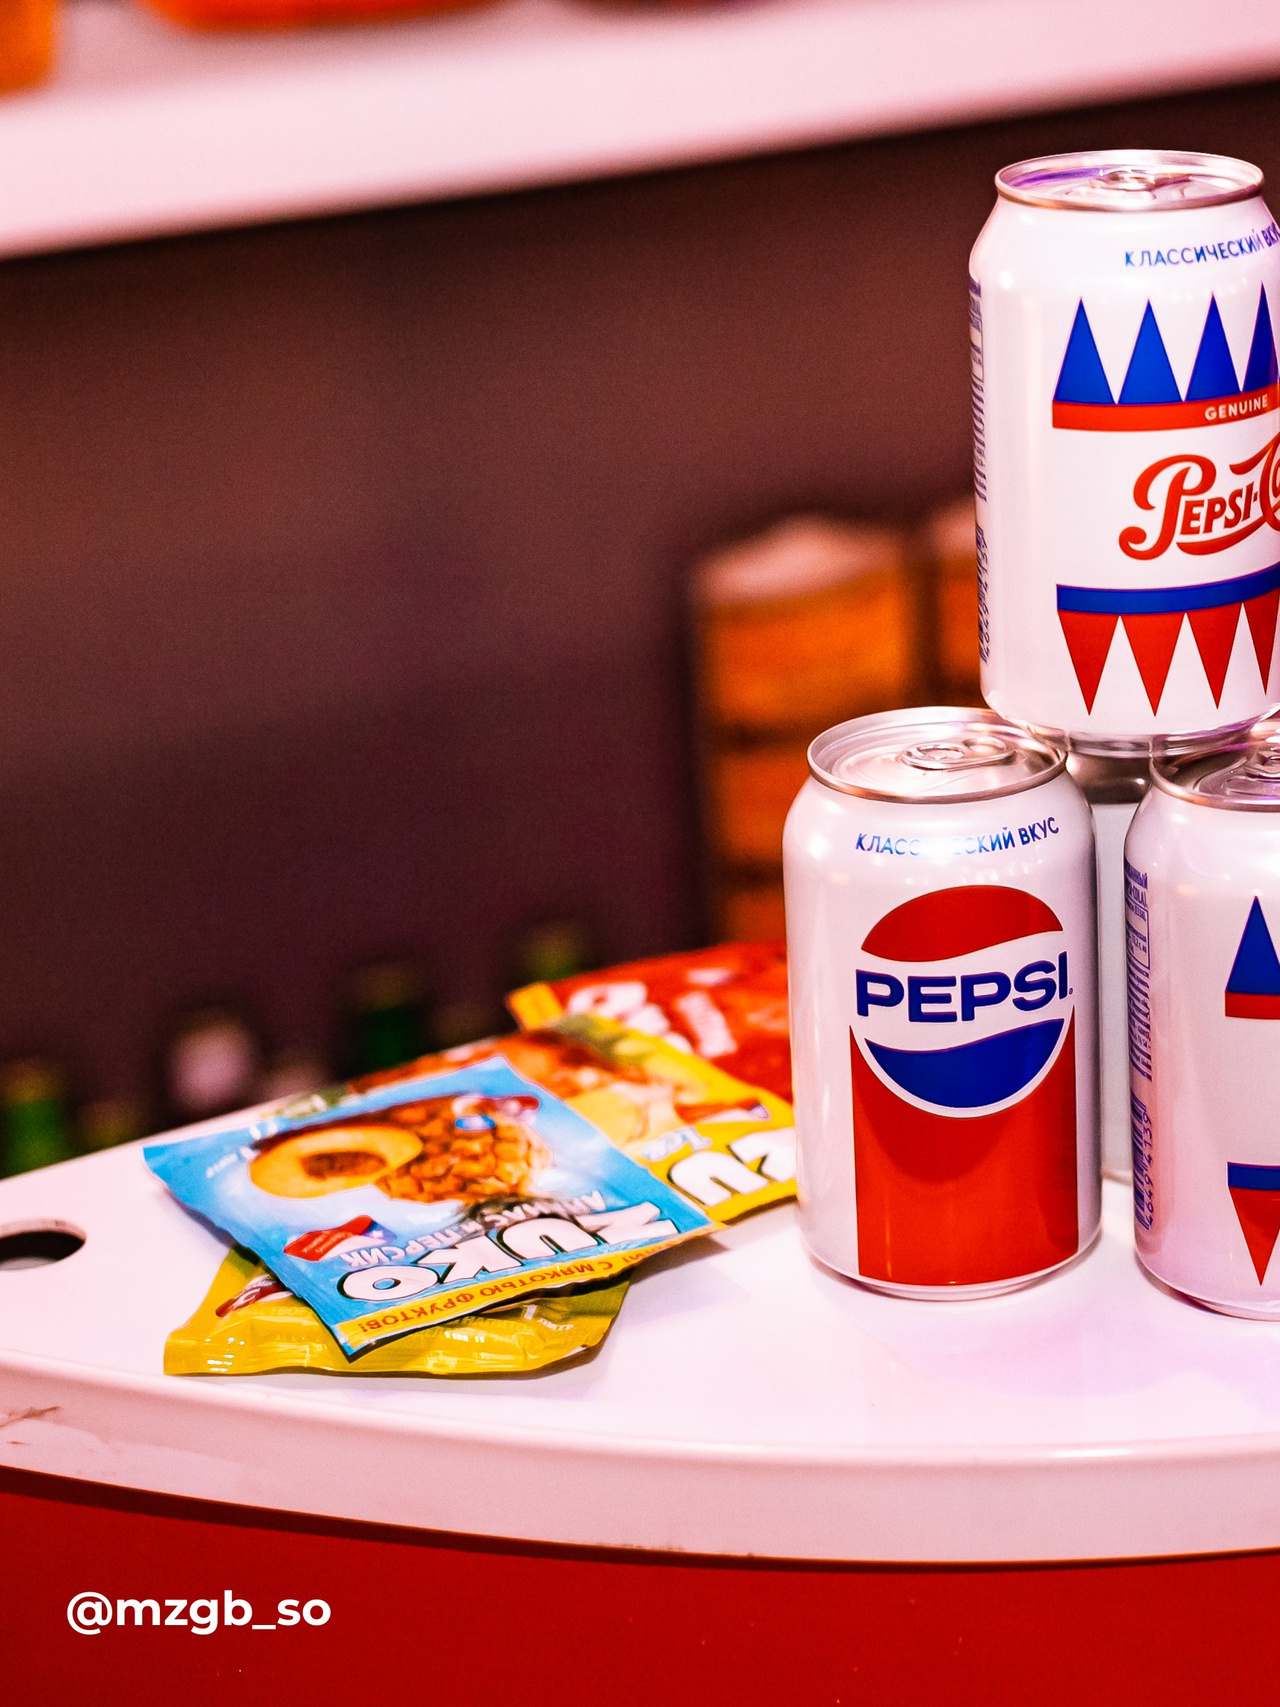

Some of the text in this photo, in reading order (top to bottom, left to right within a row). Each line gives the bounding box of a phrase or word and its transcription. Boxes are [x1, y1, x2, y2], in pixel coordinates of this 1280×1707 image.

[1125, 228, 1265, 268] КЛАССИЧЕСКИЙ
[1204, 394, 1269, 421] GENUINE
[1019, 817, 1059, 845] ВКУС
[855, 951, 1069, 1023] PEPSI
[340, 1201, 680, 1300] ZUKO
[342, 1231, 462, 1268] ПЕРСИК
[600, 1262, 613, 1272] С
[480, 1264, 595, 1299] МЯКОТЬЮ
[357, 1293, 475, 1334] ФРУКТОВ!
